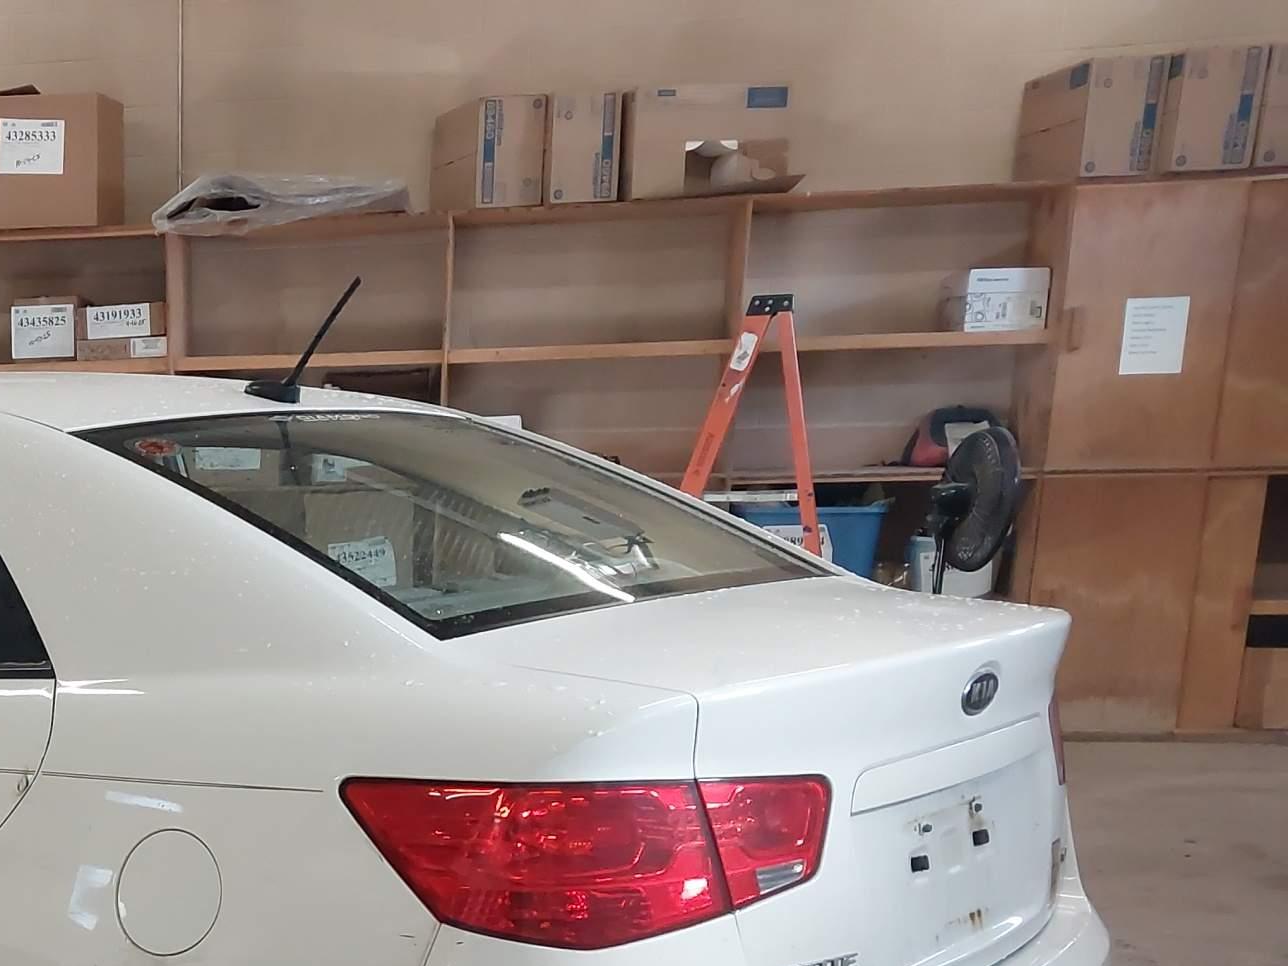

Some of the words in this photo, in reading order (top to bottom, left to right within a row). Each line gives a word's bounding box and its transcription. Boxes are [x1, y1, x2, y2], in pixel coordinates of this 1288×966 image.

[5, 130, 57, 142] 43285333
[17, 315, 67, 328] 43435825
[93, 308, 143, 322] 43191933
